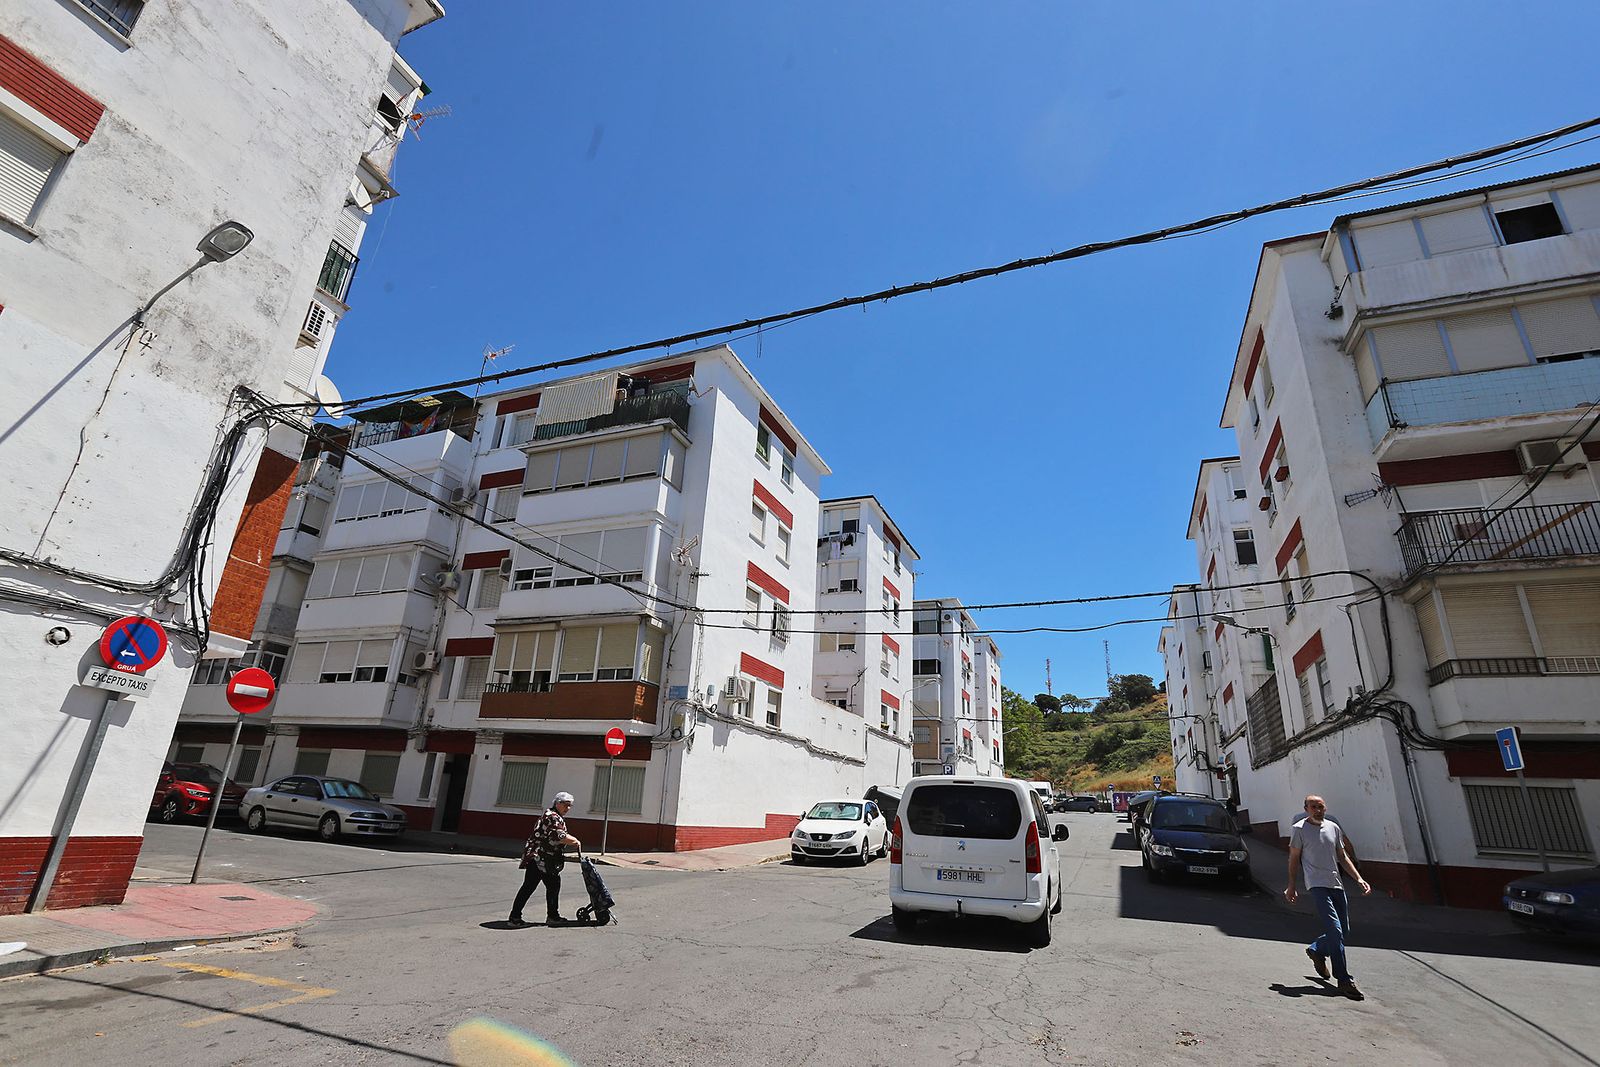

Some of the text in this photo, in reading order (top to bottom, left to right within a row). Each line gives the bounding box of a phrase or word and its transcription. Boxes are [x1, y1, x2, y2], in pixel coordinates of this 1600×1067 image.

[91, 672, 148, 691] EXCEPTO TAXIS
[944, 765, 952, 775] P
[942, 870, 983, 882] 5981 HHL
